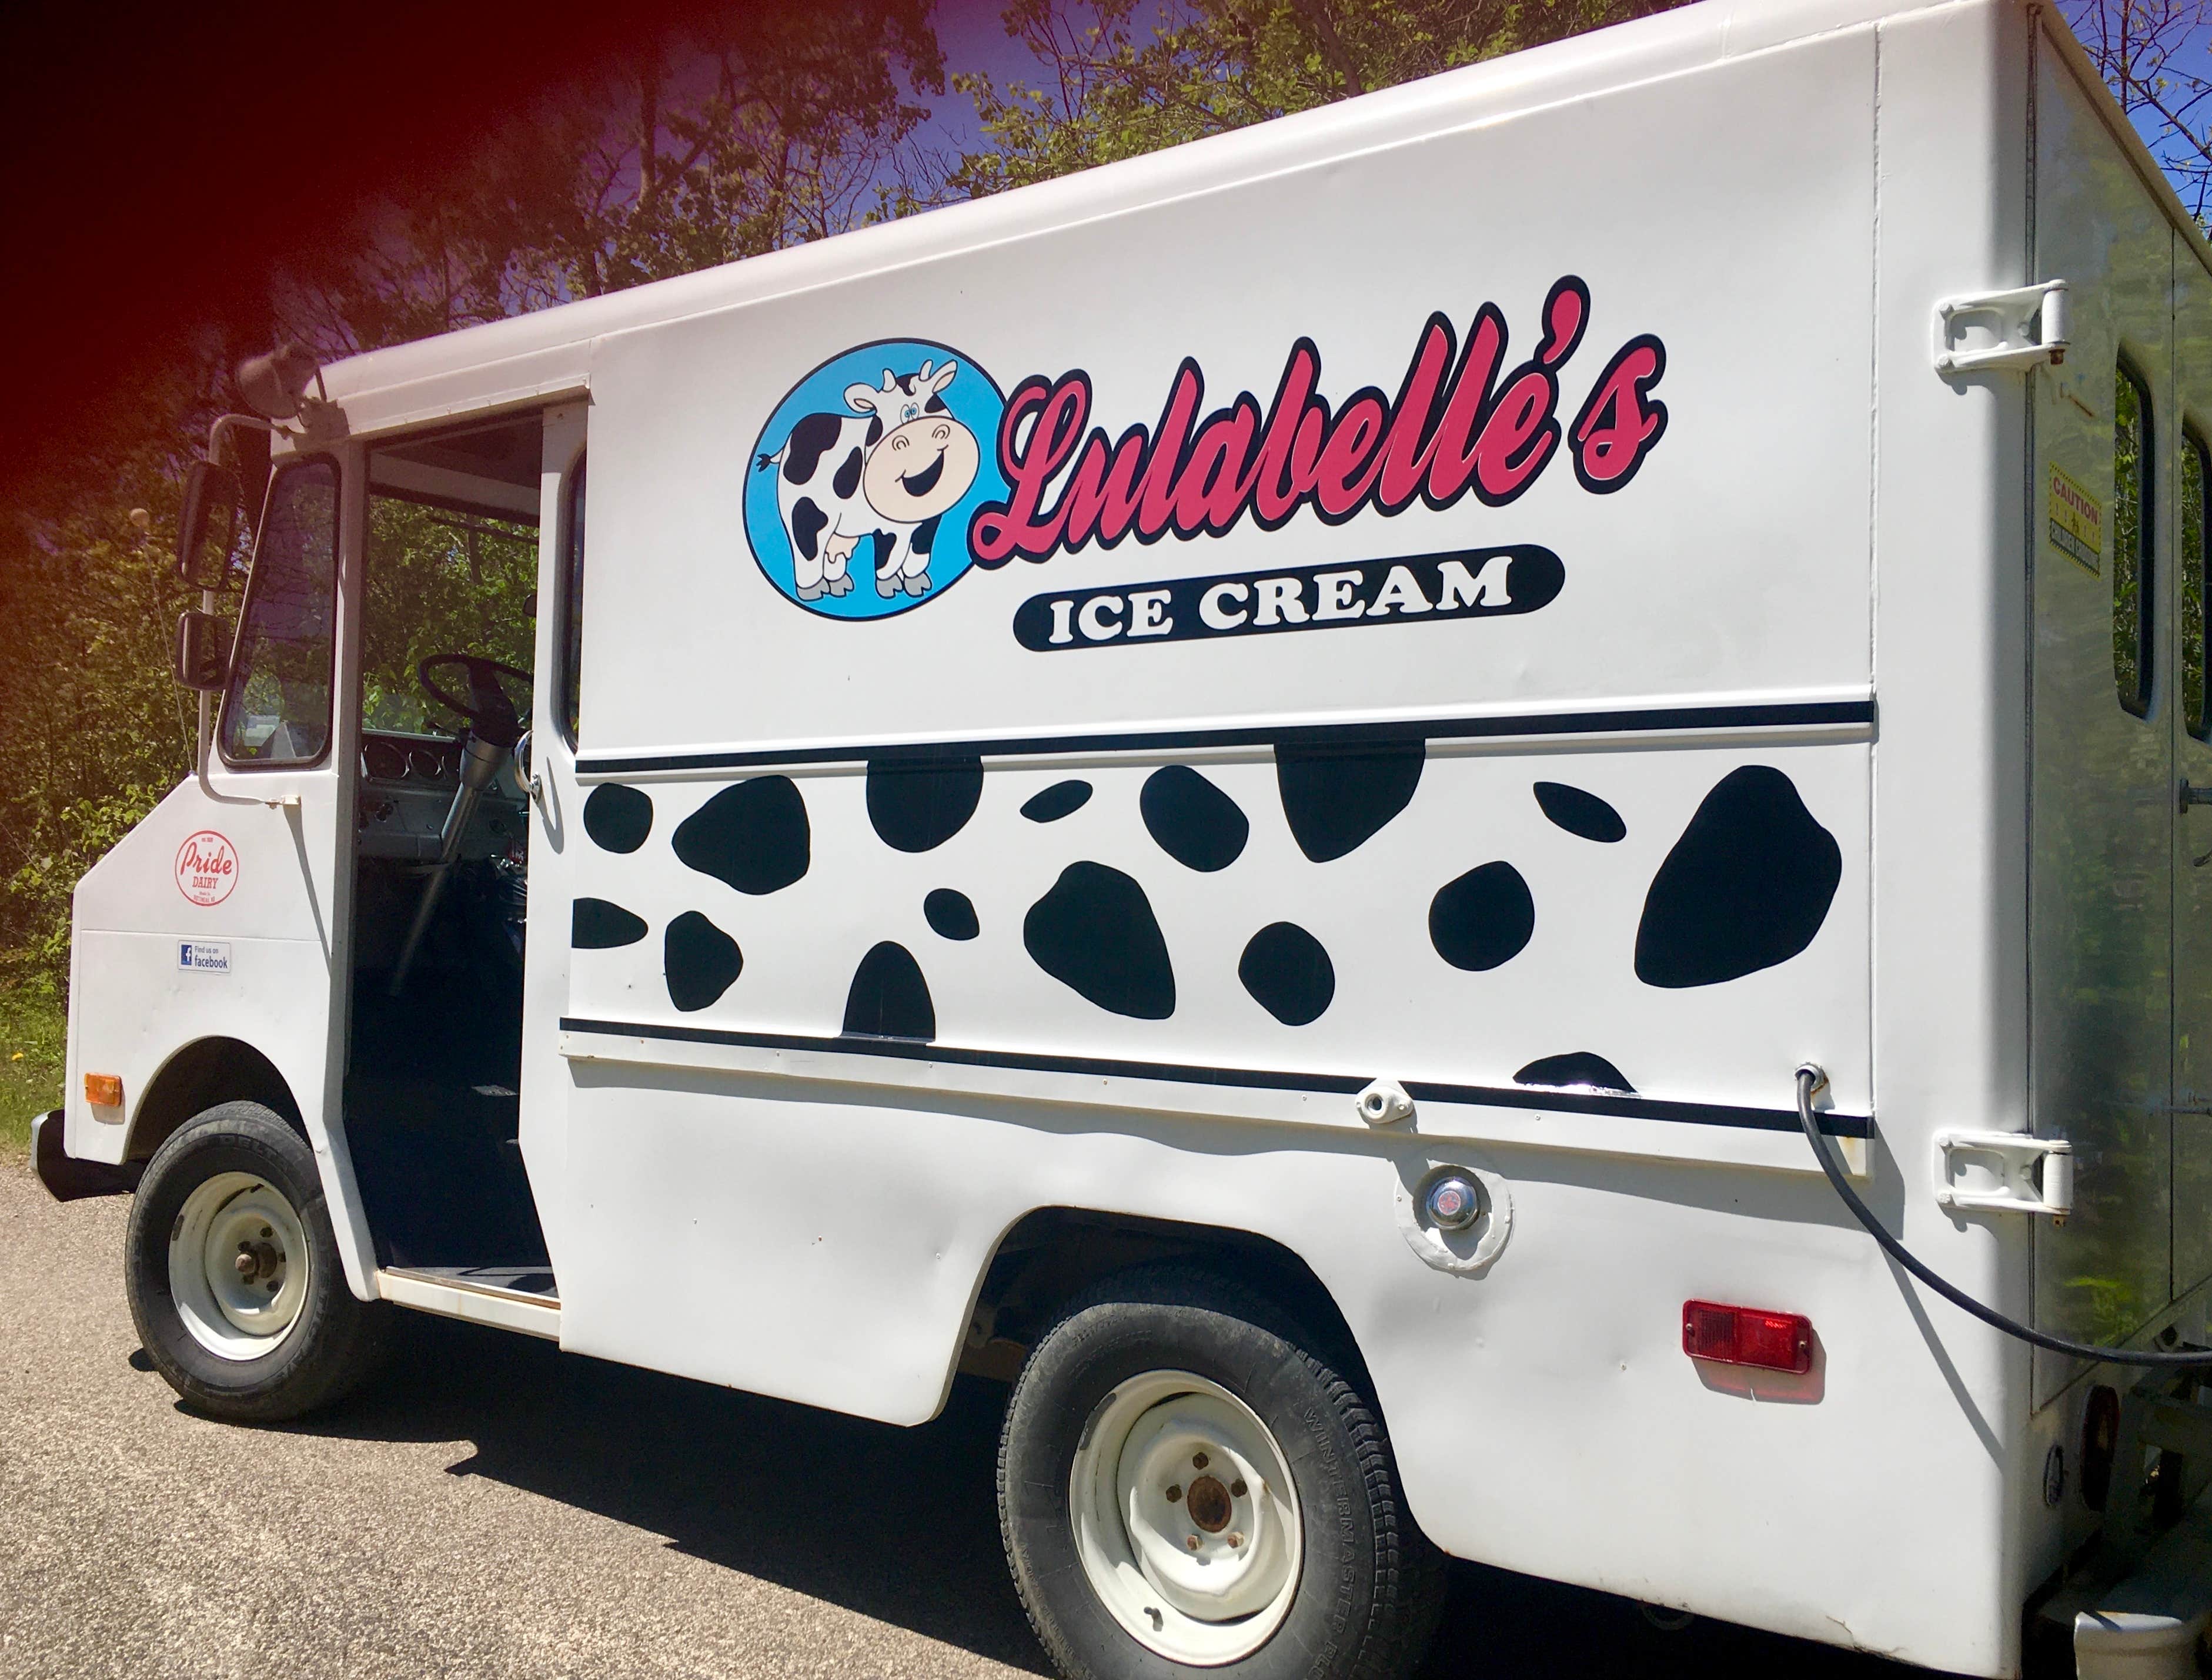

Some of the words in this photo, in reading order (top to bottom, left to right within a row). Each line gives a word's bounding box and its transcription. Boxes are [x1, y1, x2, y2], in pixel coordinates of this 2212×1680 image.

[968, 275, 1668, 570] Lulabelle's
[2053, 476, 2098, 525] CAUTION
[1048, 590, 1174, 645] ICE
[1199, 555, 1513, 630] CREAM
[180, 841, 232, 876] Pride
[192, 876, 218, 889] DAIRY
[195, 954, 228, 969] facebook
[1304, 1407, 1356, 1634] WINTERMASTER
